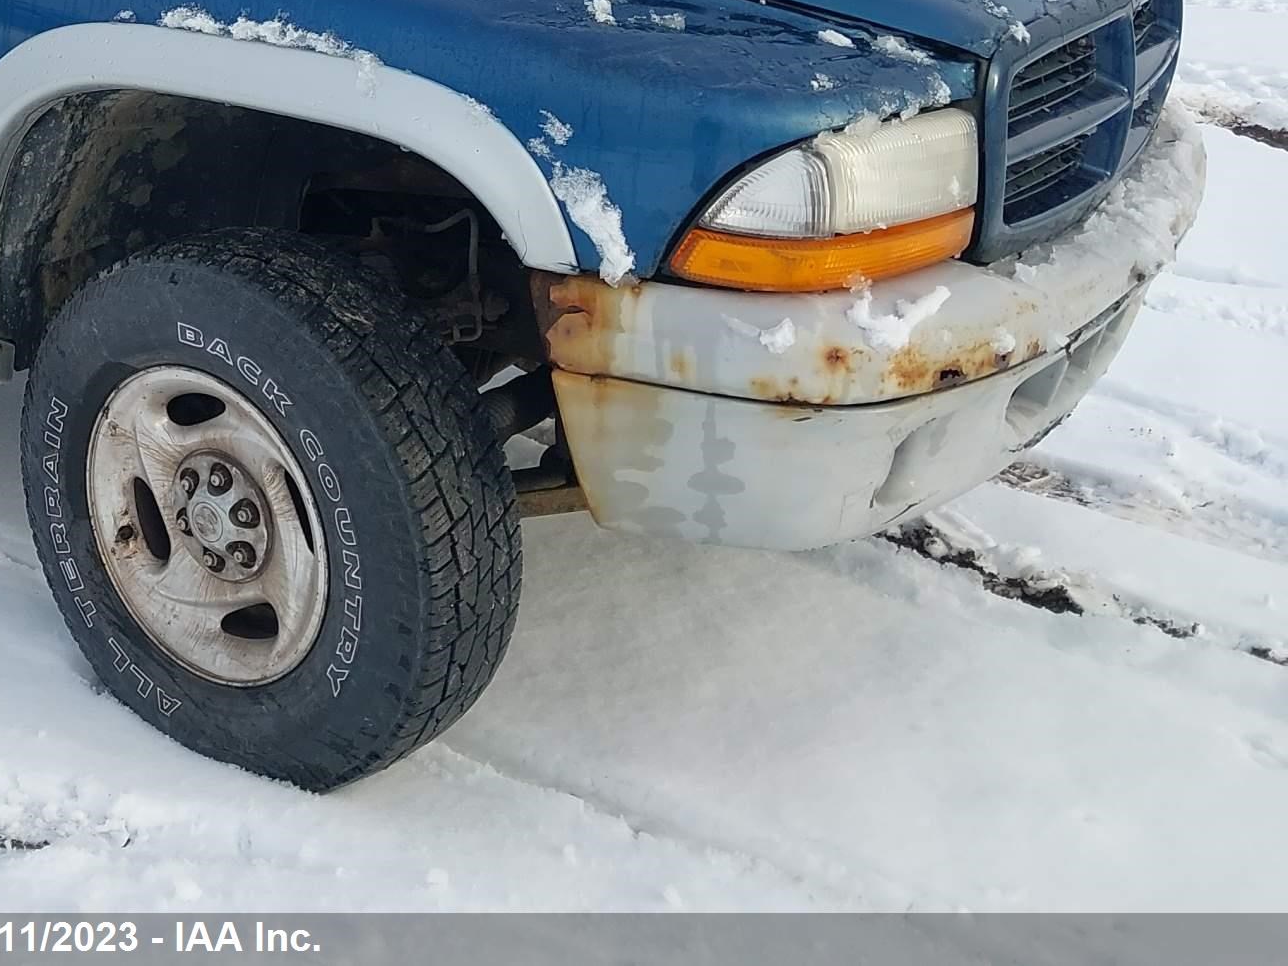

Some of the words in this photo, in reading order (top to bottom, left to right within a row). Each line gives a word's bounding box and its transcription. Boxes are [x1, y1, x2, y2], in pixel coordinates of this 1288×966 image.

[41, 397, 96, 629] TERRAIN
[177, 322, 295, 417] BACK
[299, 429, 363, 696] COUNTRY
[108, 637, 181, 717] ALL
